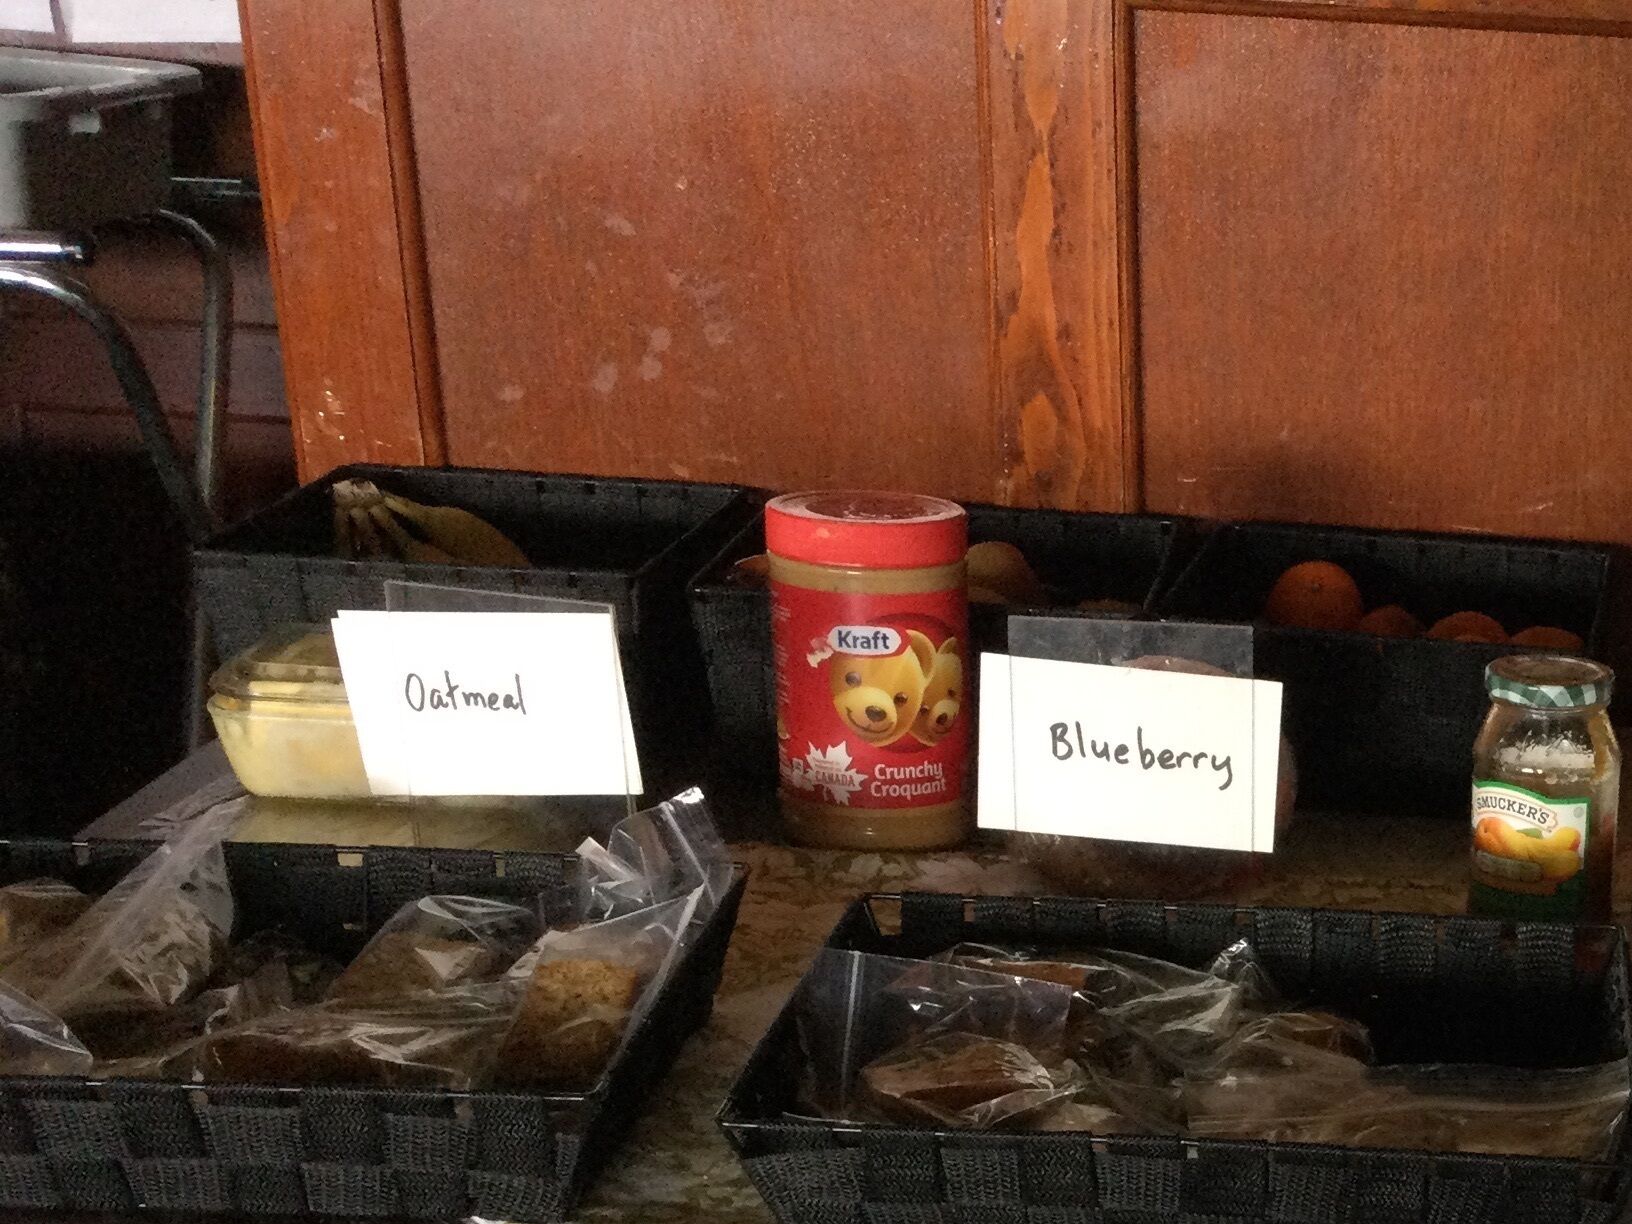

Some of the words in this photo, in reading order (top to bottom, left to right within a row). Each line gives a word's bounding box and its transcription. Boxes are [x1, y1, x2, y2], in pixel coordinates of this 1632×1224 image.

[837, 630, 890, 650] Kraft
[405, 670, 527, 715] Oatmeal
[1049, 721, 1234, 791] Blueberry
[815, 770, 855, 787] CANADA
[875, 761, 944, 781] Crunchy
[870, 778, 947, 799] Croquant
[1476, 795, 1550, 825] SMUCKER'S
